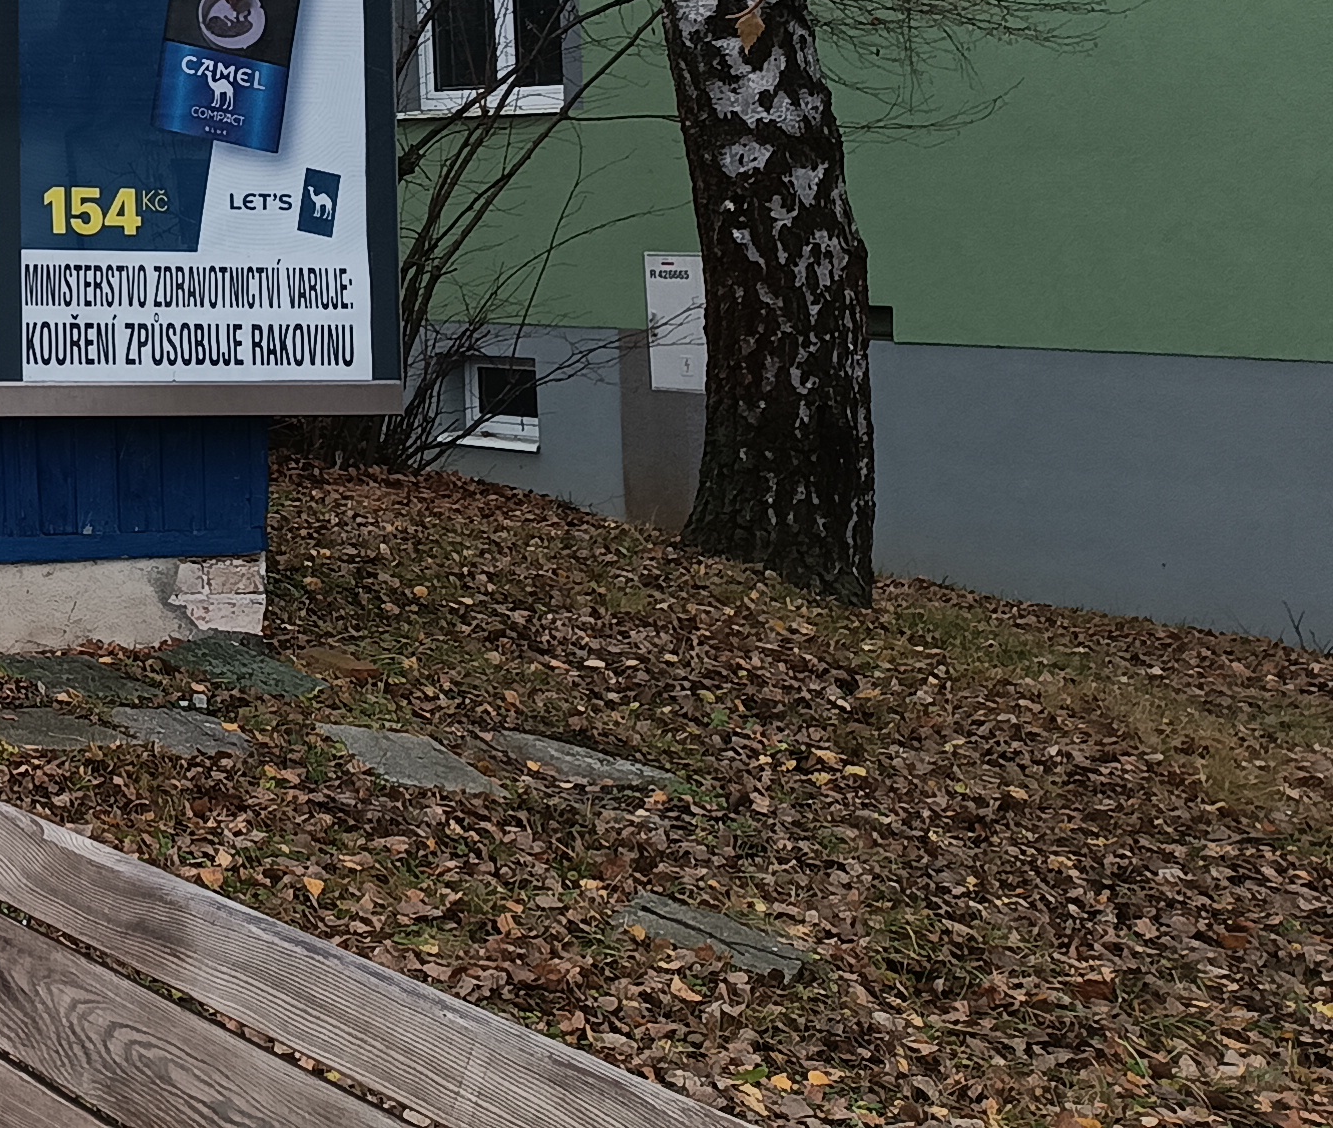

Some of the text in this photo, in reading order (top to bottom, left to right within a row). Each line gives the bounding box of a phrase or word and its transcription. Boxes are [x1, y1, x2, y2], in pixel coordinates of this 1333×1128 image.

[181, 55, 266, 90] CAMEL
[191, 106, 246, 127] COMPACT
[43, 186, 169, 236] 154 Kč
[229, 192, 293, 211] LET'S
[24, 258, 354, 310] MINISTERSTVO ZDRAVOTNICTVÍ VARUJE:
[25, 313, 355, 367] KOUŘENÍ ZPŮSOBUJE RAKOVINU
